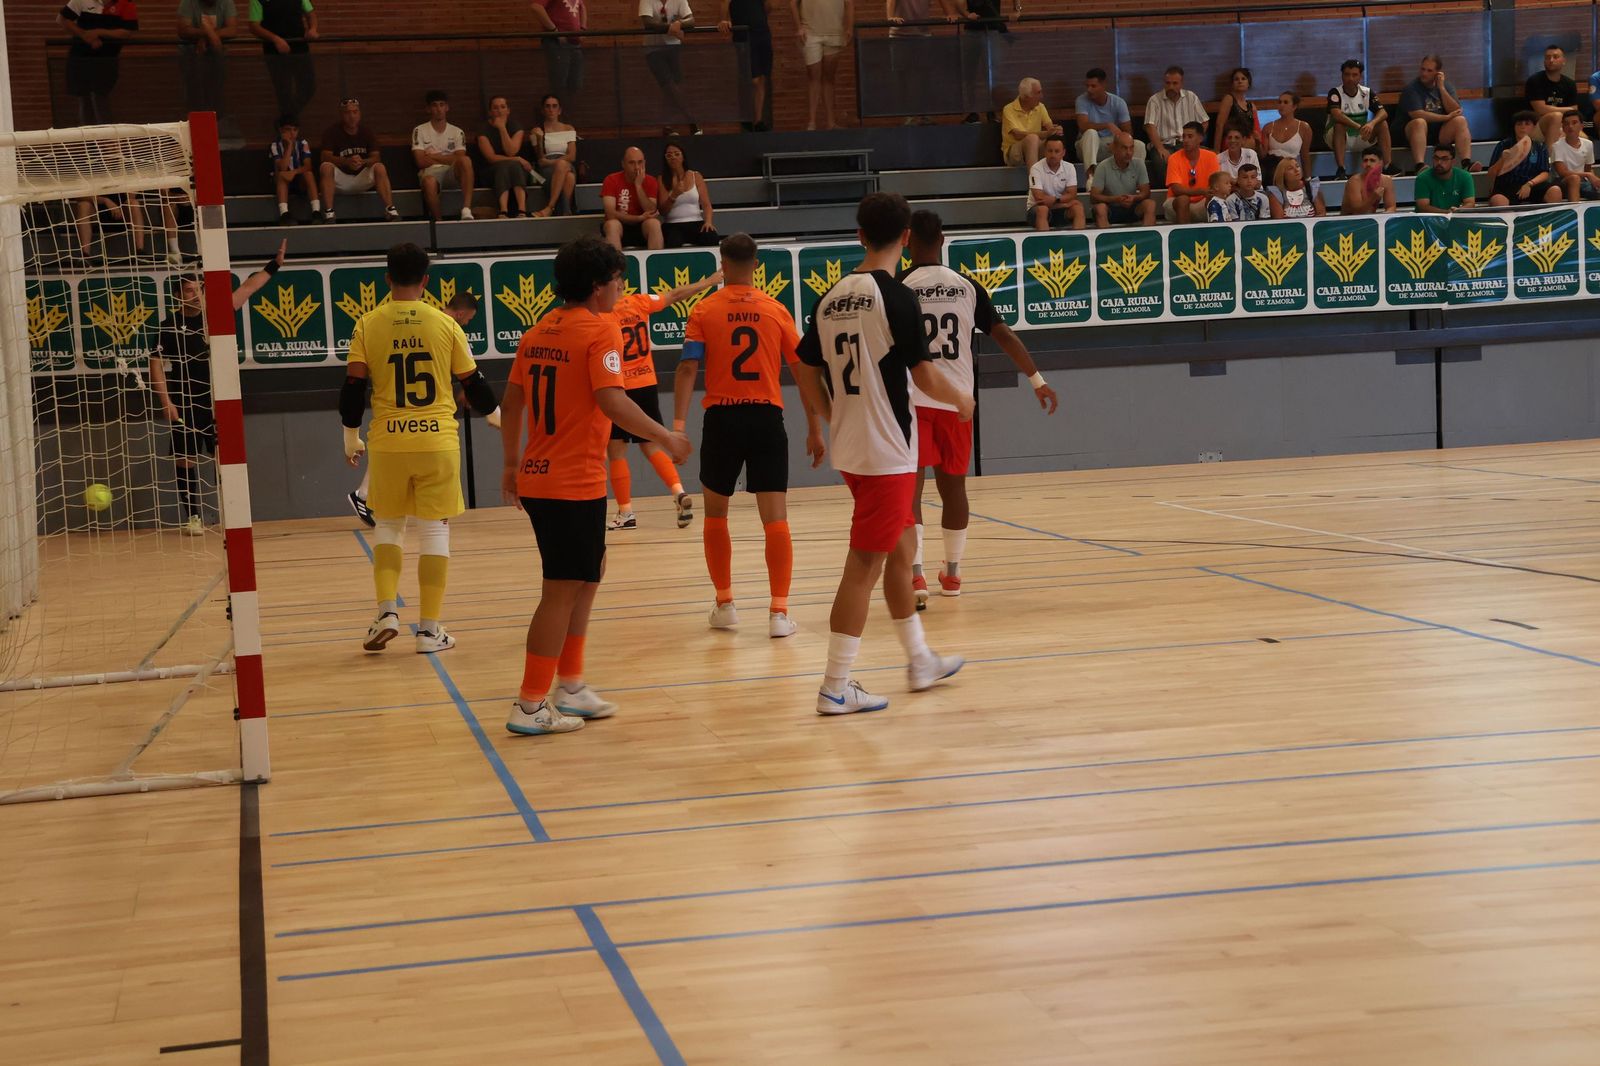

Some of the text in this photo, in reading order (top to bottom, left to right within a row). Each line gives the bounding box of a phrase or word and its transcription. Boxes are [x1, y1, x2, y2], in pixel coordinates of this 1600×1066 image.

[1472, 280, 1506, 290] RURAL
[1517, 274, 1578, 287] CAJA RURAL
[1316, 284, 1377, 296] CAJA RURAL
[1388, 282, 1447, 292] CAJA RURAL
[1173, 291, 1234, 303] CAJA RURAL
[1245, 288, 1306, 299] CAJA RURAL
[1027, 300, 1089, 312] CAJA RURAL
[1100, 296, 1162, 308] CAJA RURAL
[995, 304, 1016, 314] RAL
[727, 313, 760, 322] DAVID
[652, 322, 679, 332] CAJA
[393, 336, 424, 349] RAÚL
[621, 321, 649, 361] 20
[922, 313, 960, 360] 23
[255, 341, 283, 352] CAJA
[285, 340, 325, 352] RURAL
[731, 326, 760, 380] 2
[835, 332, 860, 395] 21
[387, 351, 436, 408] 15
[528, 364, 557, 436] 11
[387, 419, 440, 433] uvesa
[520, 458, 550, 474] esa
